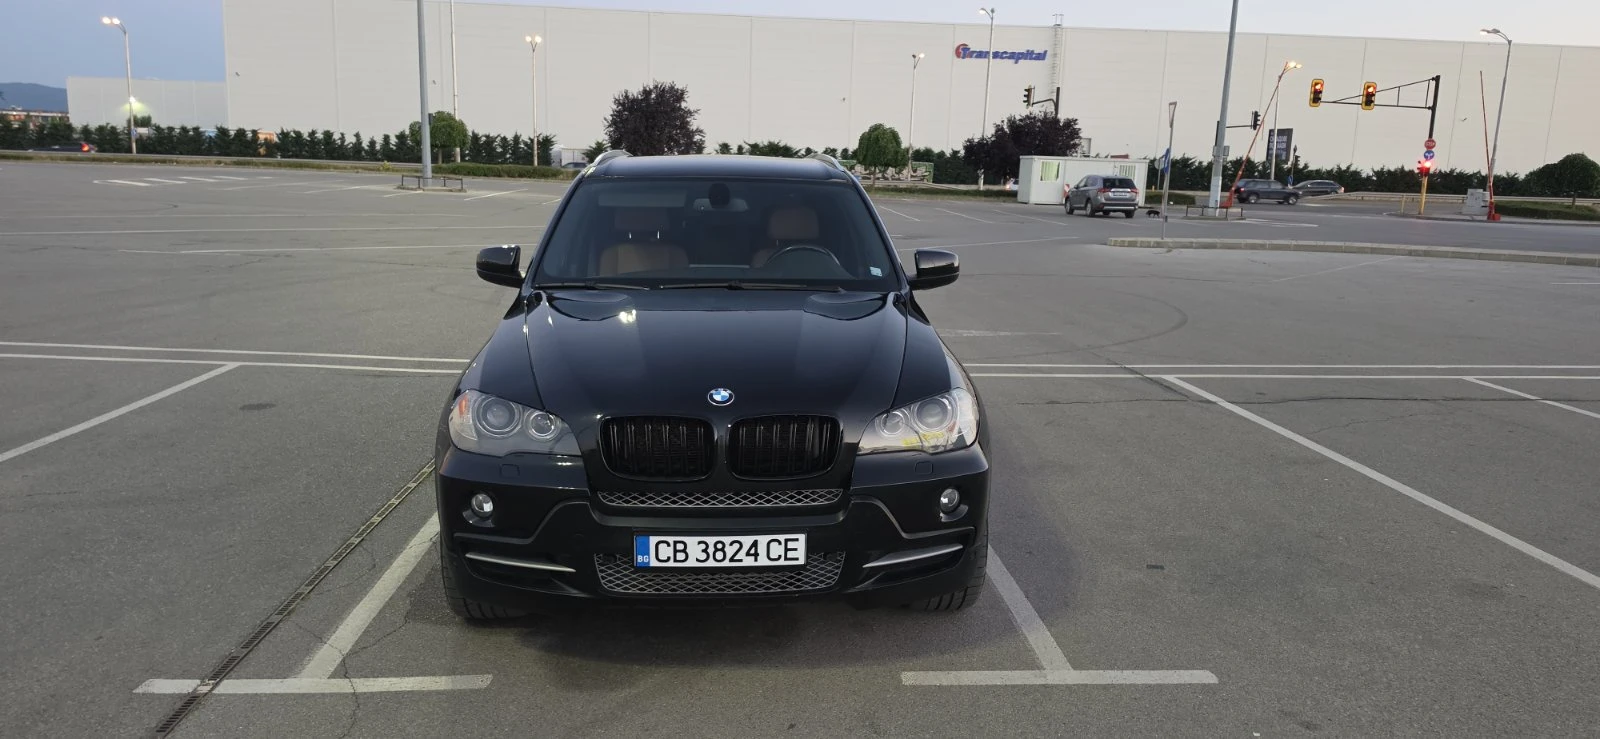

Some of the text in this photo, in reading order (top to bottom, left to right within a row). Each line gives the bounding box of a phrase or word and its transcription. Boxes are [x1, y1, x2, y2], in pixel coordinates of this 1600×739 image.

[960, 46, 1048, 64] Transcapital
[637, 555, 649, 563] BG
[654, 538, 799, 563] CB 3824 CE
